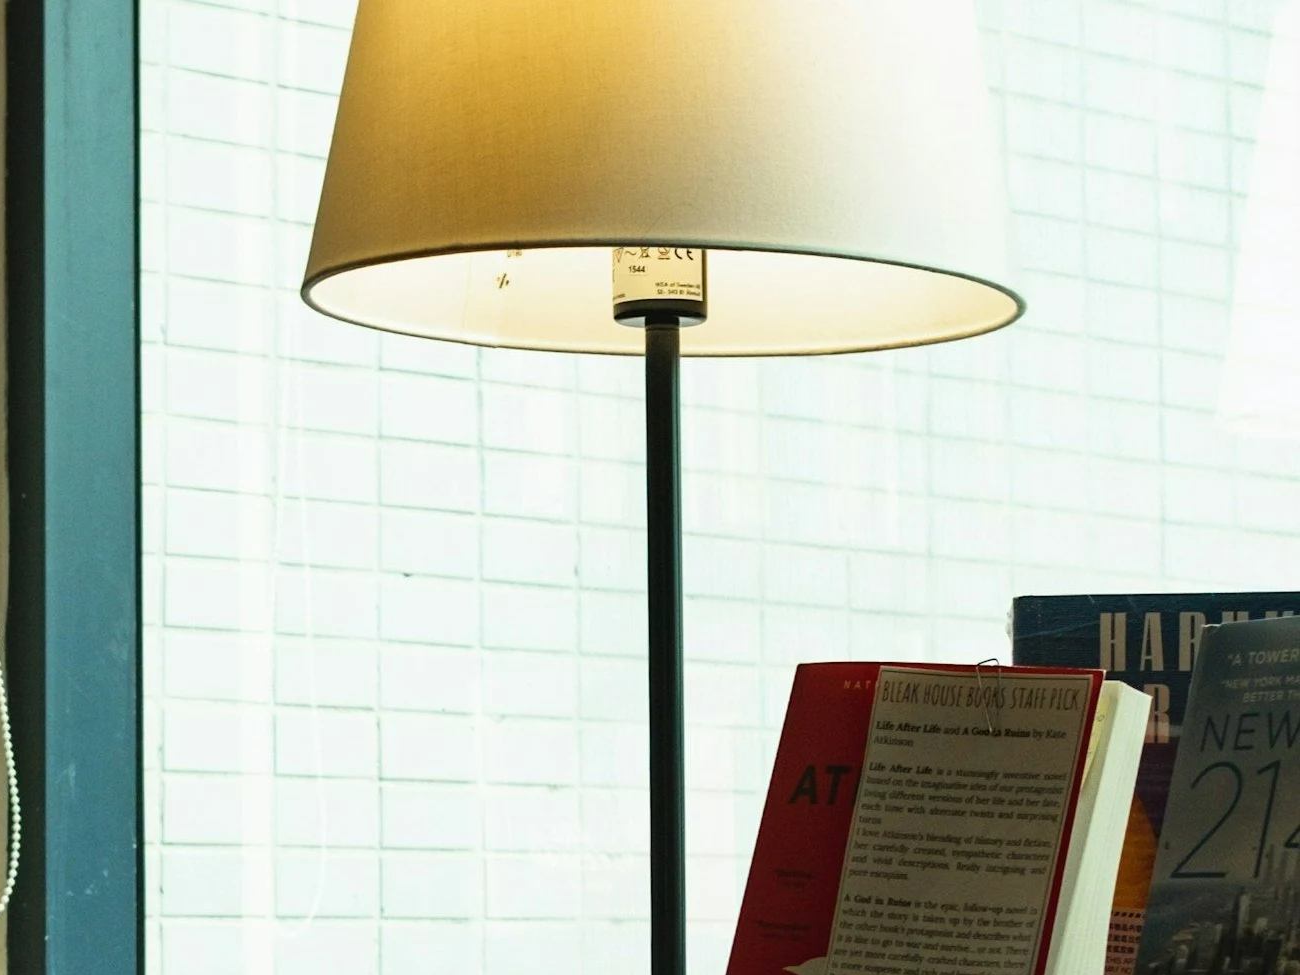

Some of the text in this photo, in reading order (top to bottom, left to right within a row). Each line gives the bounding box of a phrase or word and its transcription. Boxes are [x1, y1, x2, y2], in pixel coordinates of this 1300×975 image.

[628, 265, 645, 273] 1544
[882, 681, 919, 704] BLEAK
[923, 685, 963, 706] HOUSE
[966, 687, 1006, 709] BOOKS
[1010, 687, 1047, 710] STAFF
[1051, 688, 1080, 711] PICK
[876, 720, 1067, 739] Life After Life and Ruins by Kate
[874, 736, 913, 747] Atkinson
